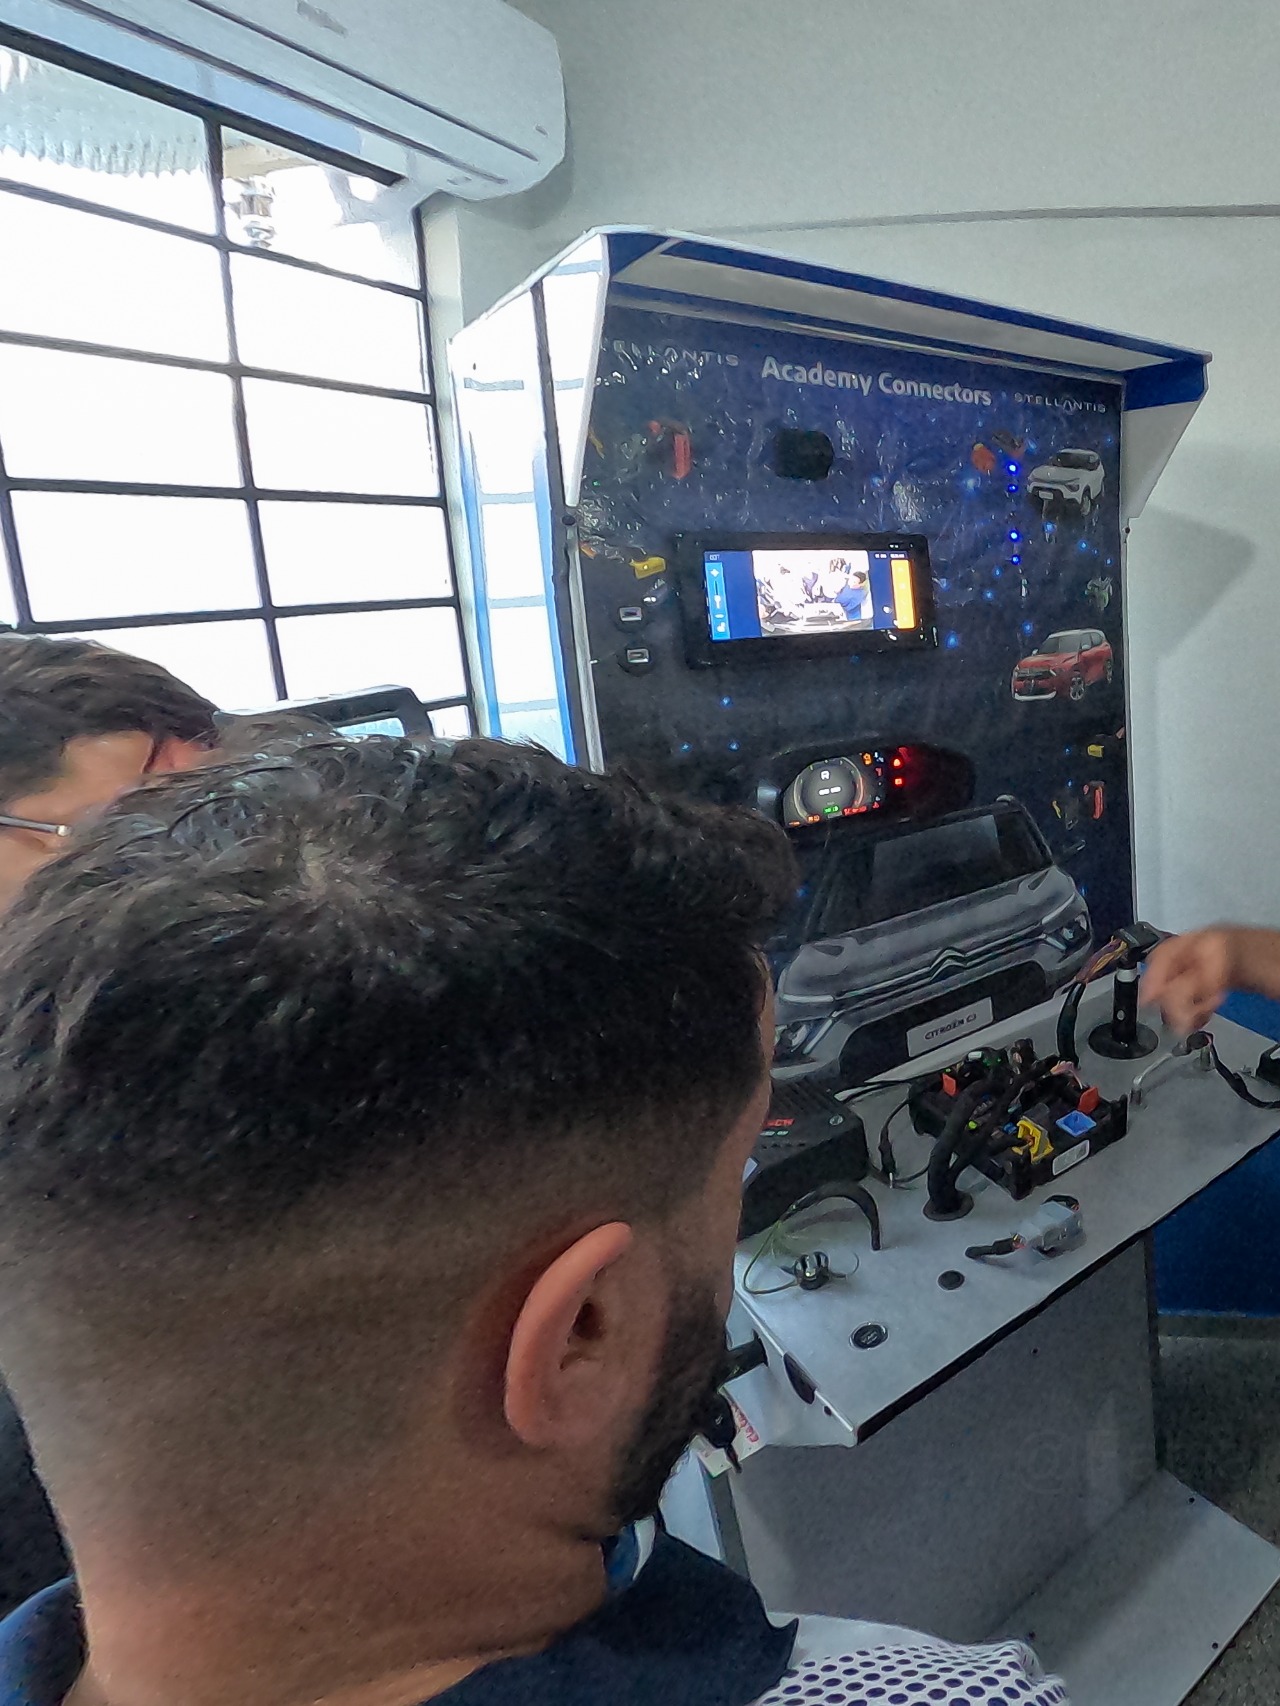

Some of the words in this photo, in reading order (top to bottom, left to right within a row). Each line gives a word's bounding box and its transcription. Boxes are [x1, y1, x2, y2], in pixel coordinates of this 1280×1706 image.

[761, 355, 873, 397] Academy
[878, 371, 992, 407] Connectors
[1014, 391, 1107, 415] STELLANTIS
